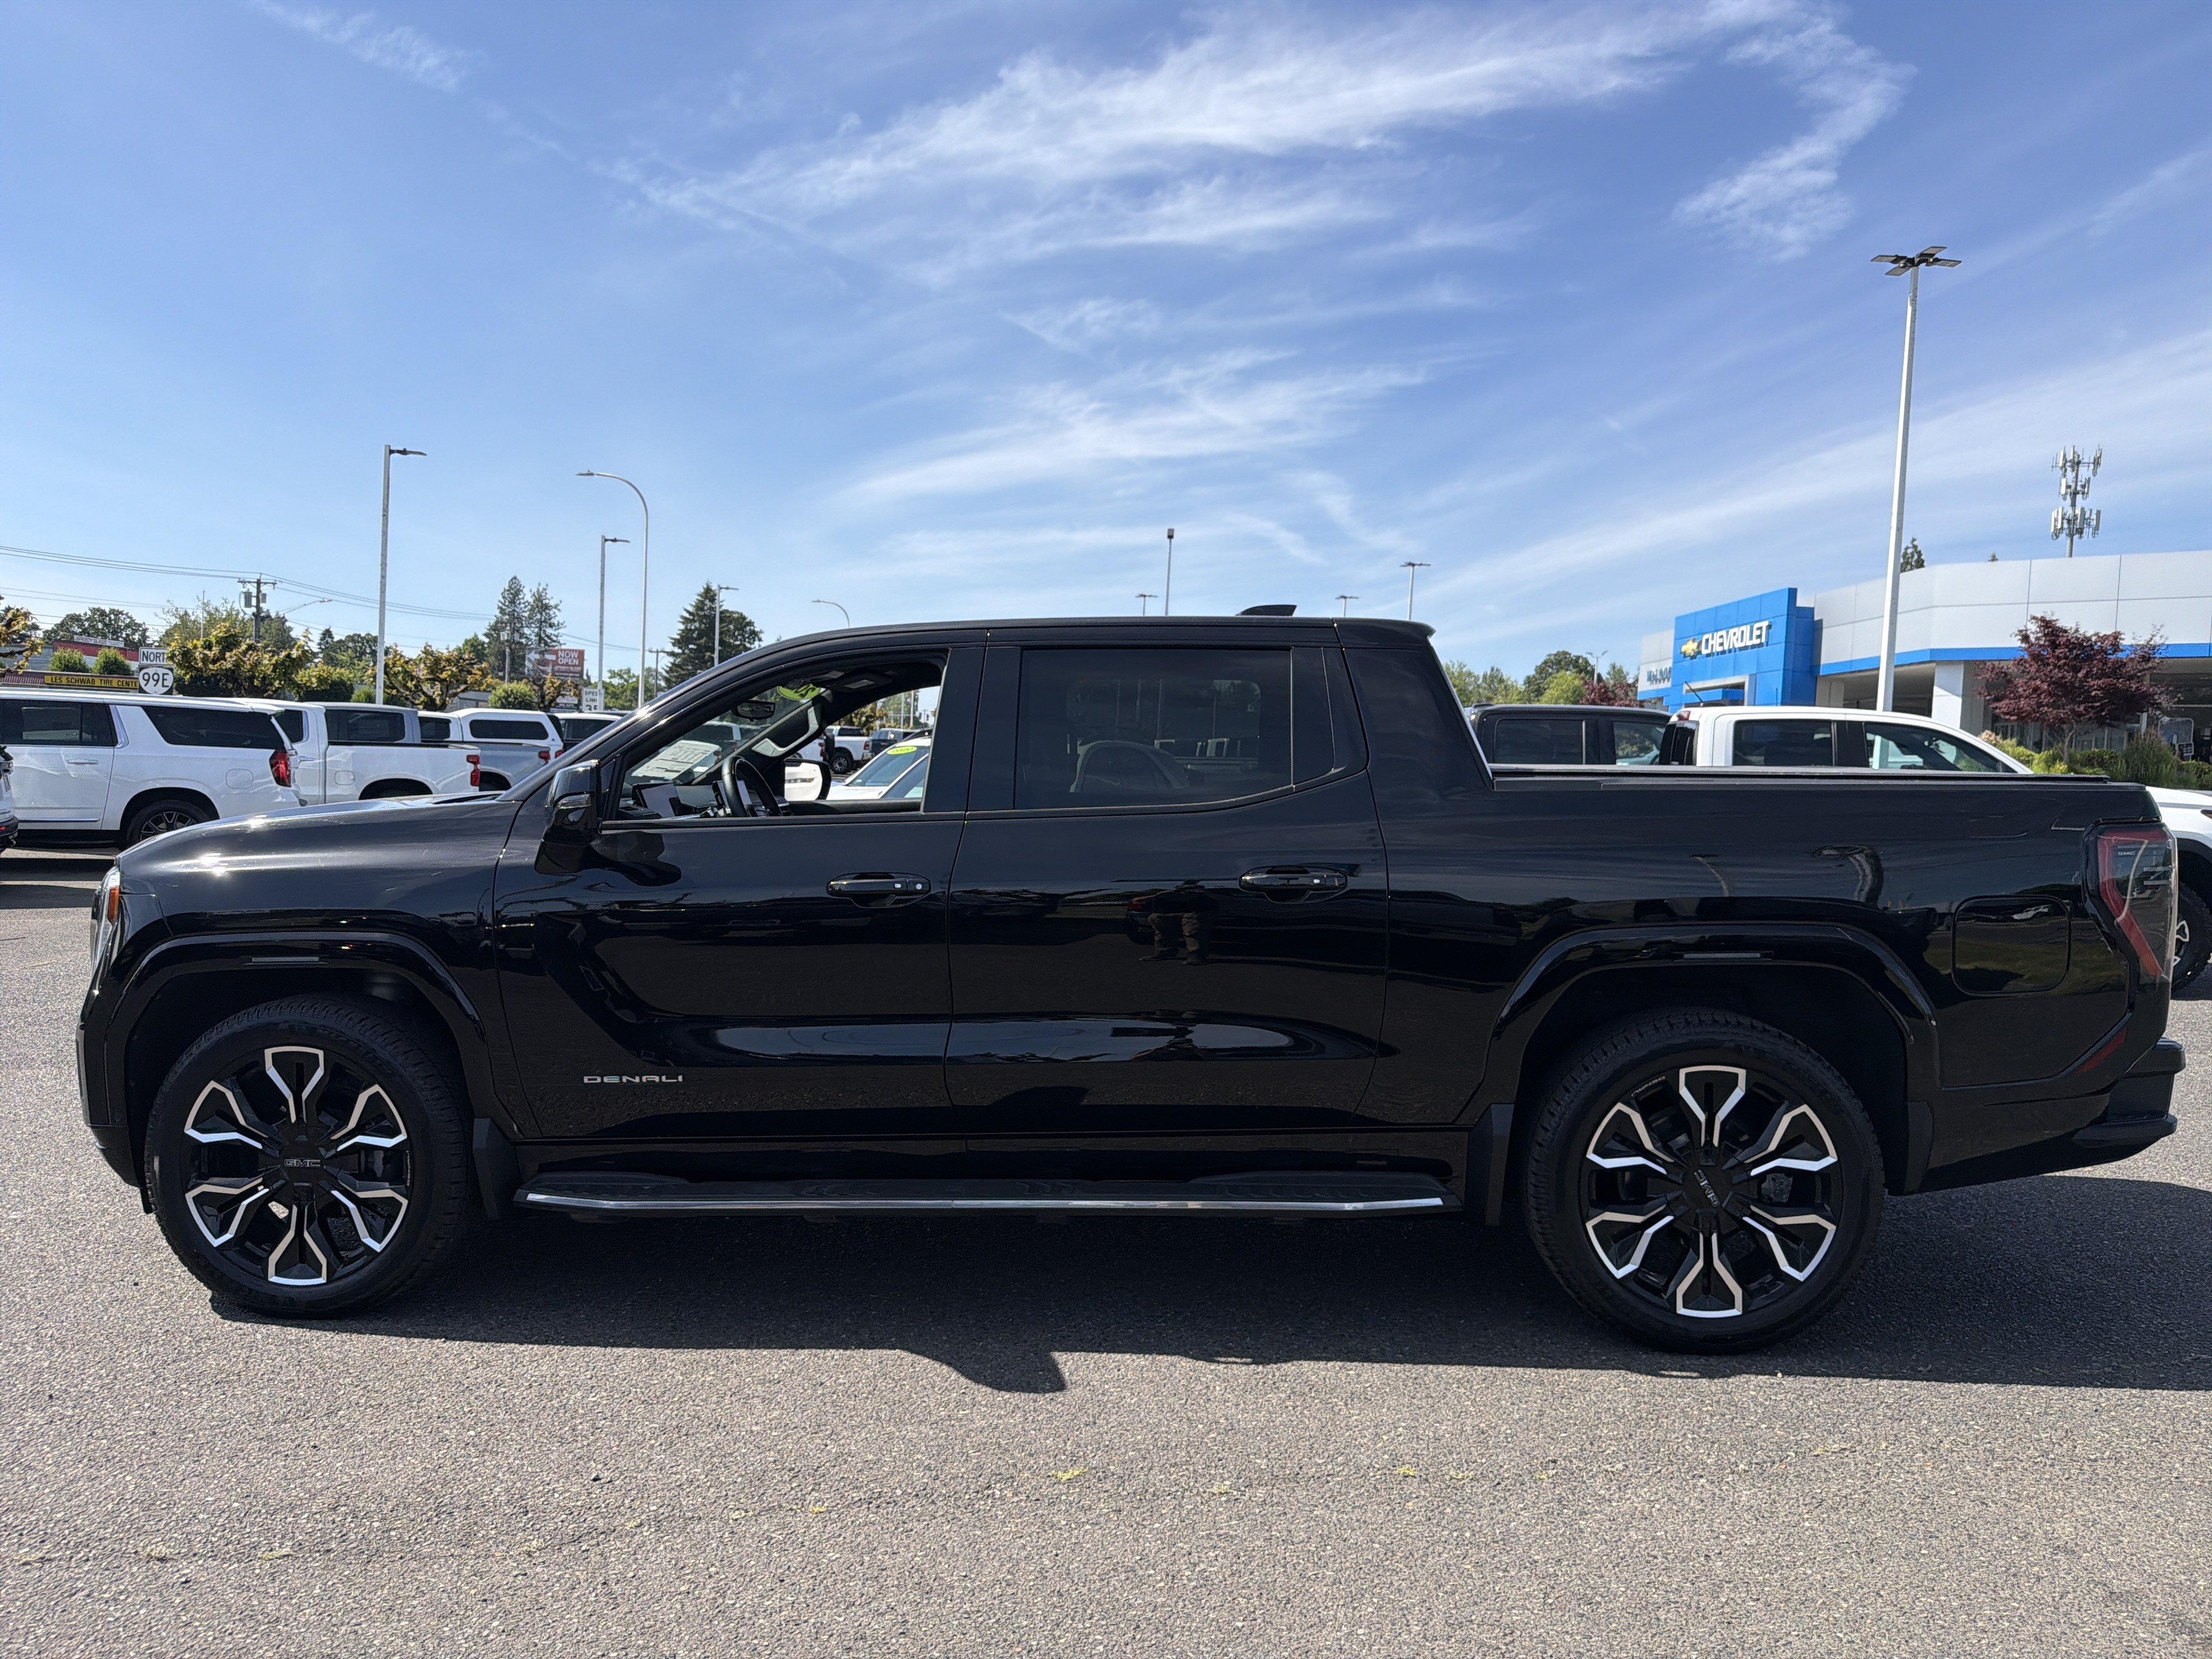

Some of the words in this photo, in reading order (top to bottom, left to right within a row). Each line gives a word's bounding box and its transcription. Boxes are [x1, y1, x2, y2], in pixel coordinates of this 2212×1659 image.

[1701, 620, 1769, 654] CHEVROLET
[142, 651, 168, 662] NORT
[66, 676, 95, 685] SCHWAB
[143, 672, 169, 687] 99E
[583, 1075, 683, 1084] DENALI
[284, 1159, 320, 1167] GMC
[1694, 1170, 1720, 1206] GMC
